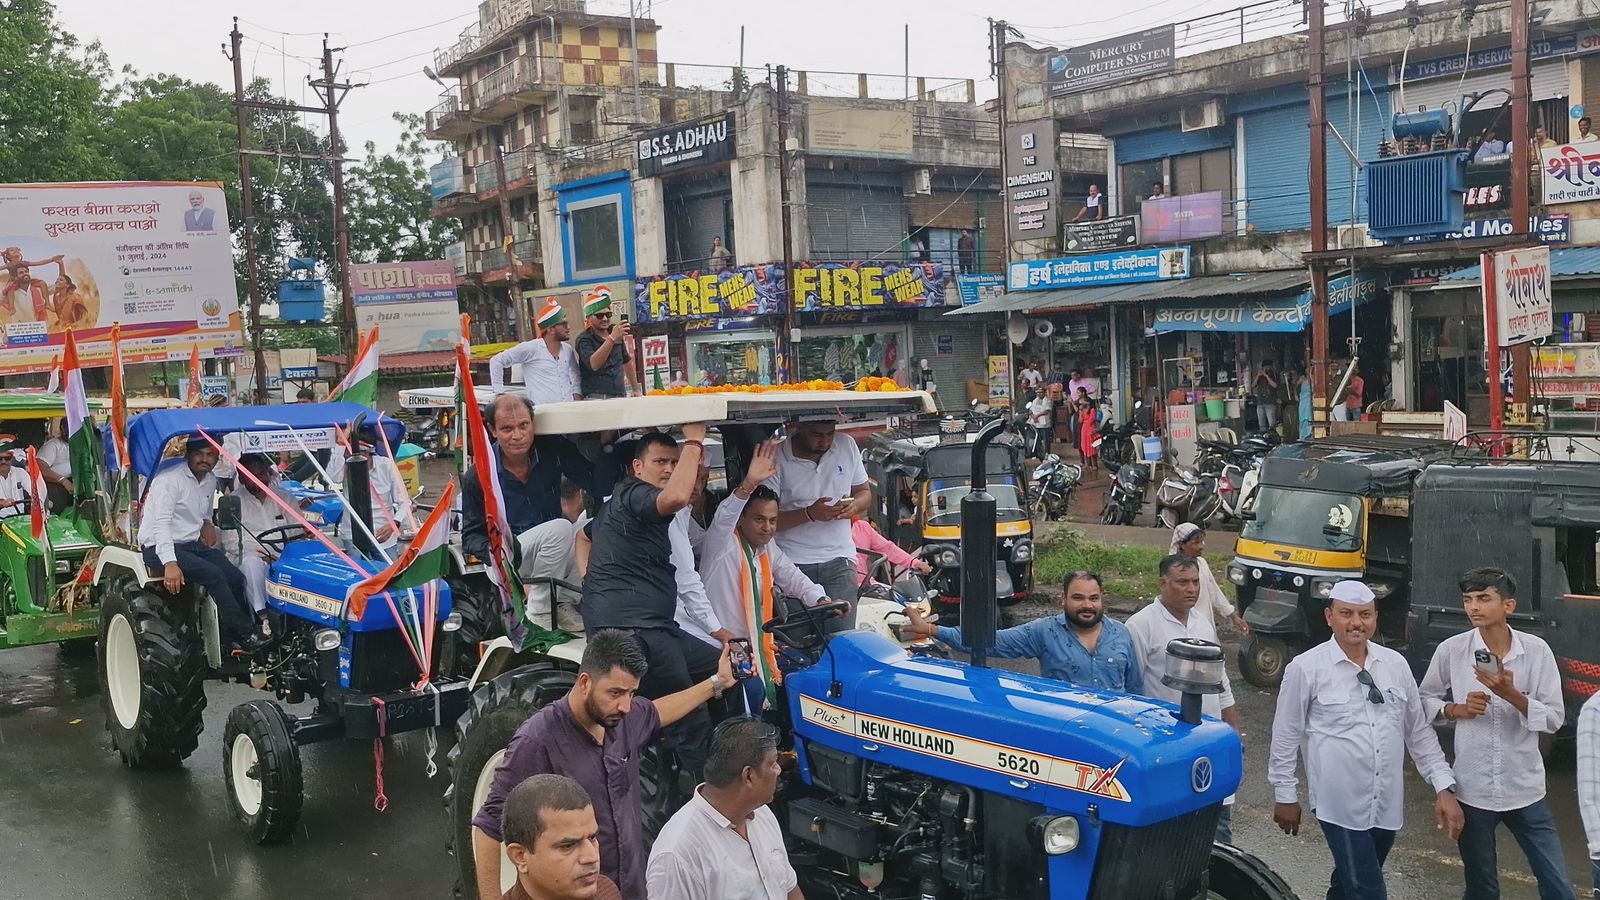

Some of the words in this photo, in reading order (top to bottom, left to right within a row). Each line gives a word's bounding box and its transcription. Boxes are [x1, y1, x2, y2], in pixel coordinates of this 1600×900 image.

[1089, 40, 1144, 61] MERCURY
[1064, 58, 1124, 79] COMPUTER
[1125, 47, 1171, 66] SYSTEM
[1417, 62, 1437, 76] TVS
[1439, 54, 1475, 73] CREDIT
[651, 134, 674, 157] S.S.
[674, 120, 727, 152] ADHAU
[1022, 155, 1035, 166] THE
[1006, 169, 1053, 187] DIMENSION
[1013, 188, 1048, 201] ASSOCIATES
[41, 206, 81, 217] फसल
[84, 202, 114, 216] बीमा
[117, 199, 161, 215] कराओ
[1174, 210, 1194, 219] TATA
[44, 222, 85, 238] सुरक्षा
[88, 220, 125, 231] कवच
[128, 216, 159, 231] पाओ
[115, 243, 143, 252] पंजीकरण
[145, 242, 154, 251] की
[150, 252, 167, 260] 2024
[414, 271, 453, 289] ट्रेवल्स
[1029, 262, 1053, 286] हर्ष
[1506, 254, 1550, 309] श्रीनाथ
[649, 274, 720, 318] FIRE
[728, 283, 757, 310] WEAR
[793, 267, 884, 308] FIRE
[894, 278, 925, 303] WEAR
[1156, 300, 1244, 329] अन्नपूर्णा
[203, 384, 227, 395] ट्रेवल्स
[408, 395, 430, 405] EICHER
[279, 588, 288, 599] NEW
[288, 591, 309, 605] HOLLAND
[861, 719, 890, 740] NEW
[892, 727, 955, 756] HOLLAND
[997, 751, 1040, 776] 5620
[1075, 757, 1124, 796] TX
